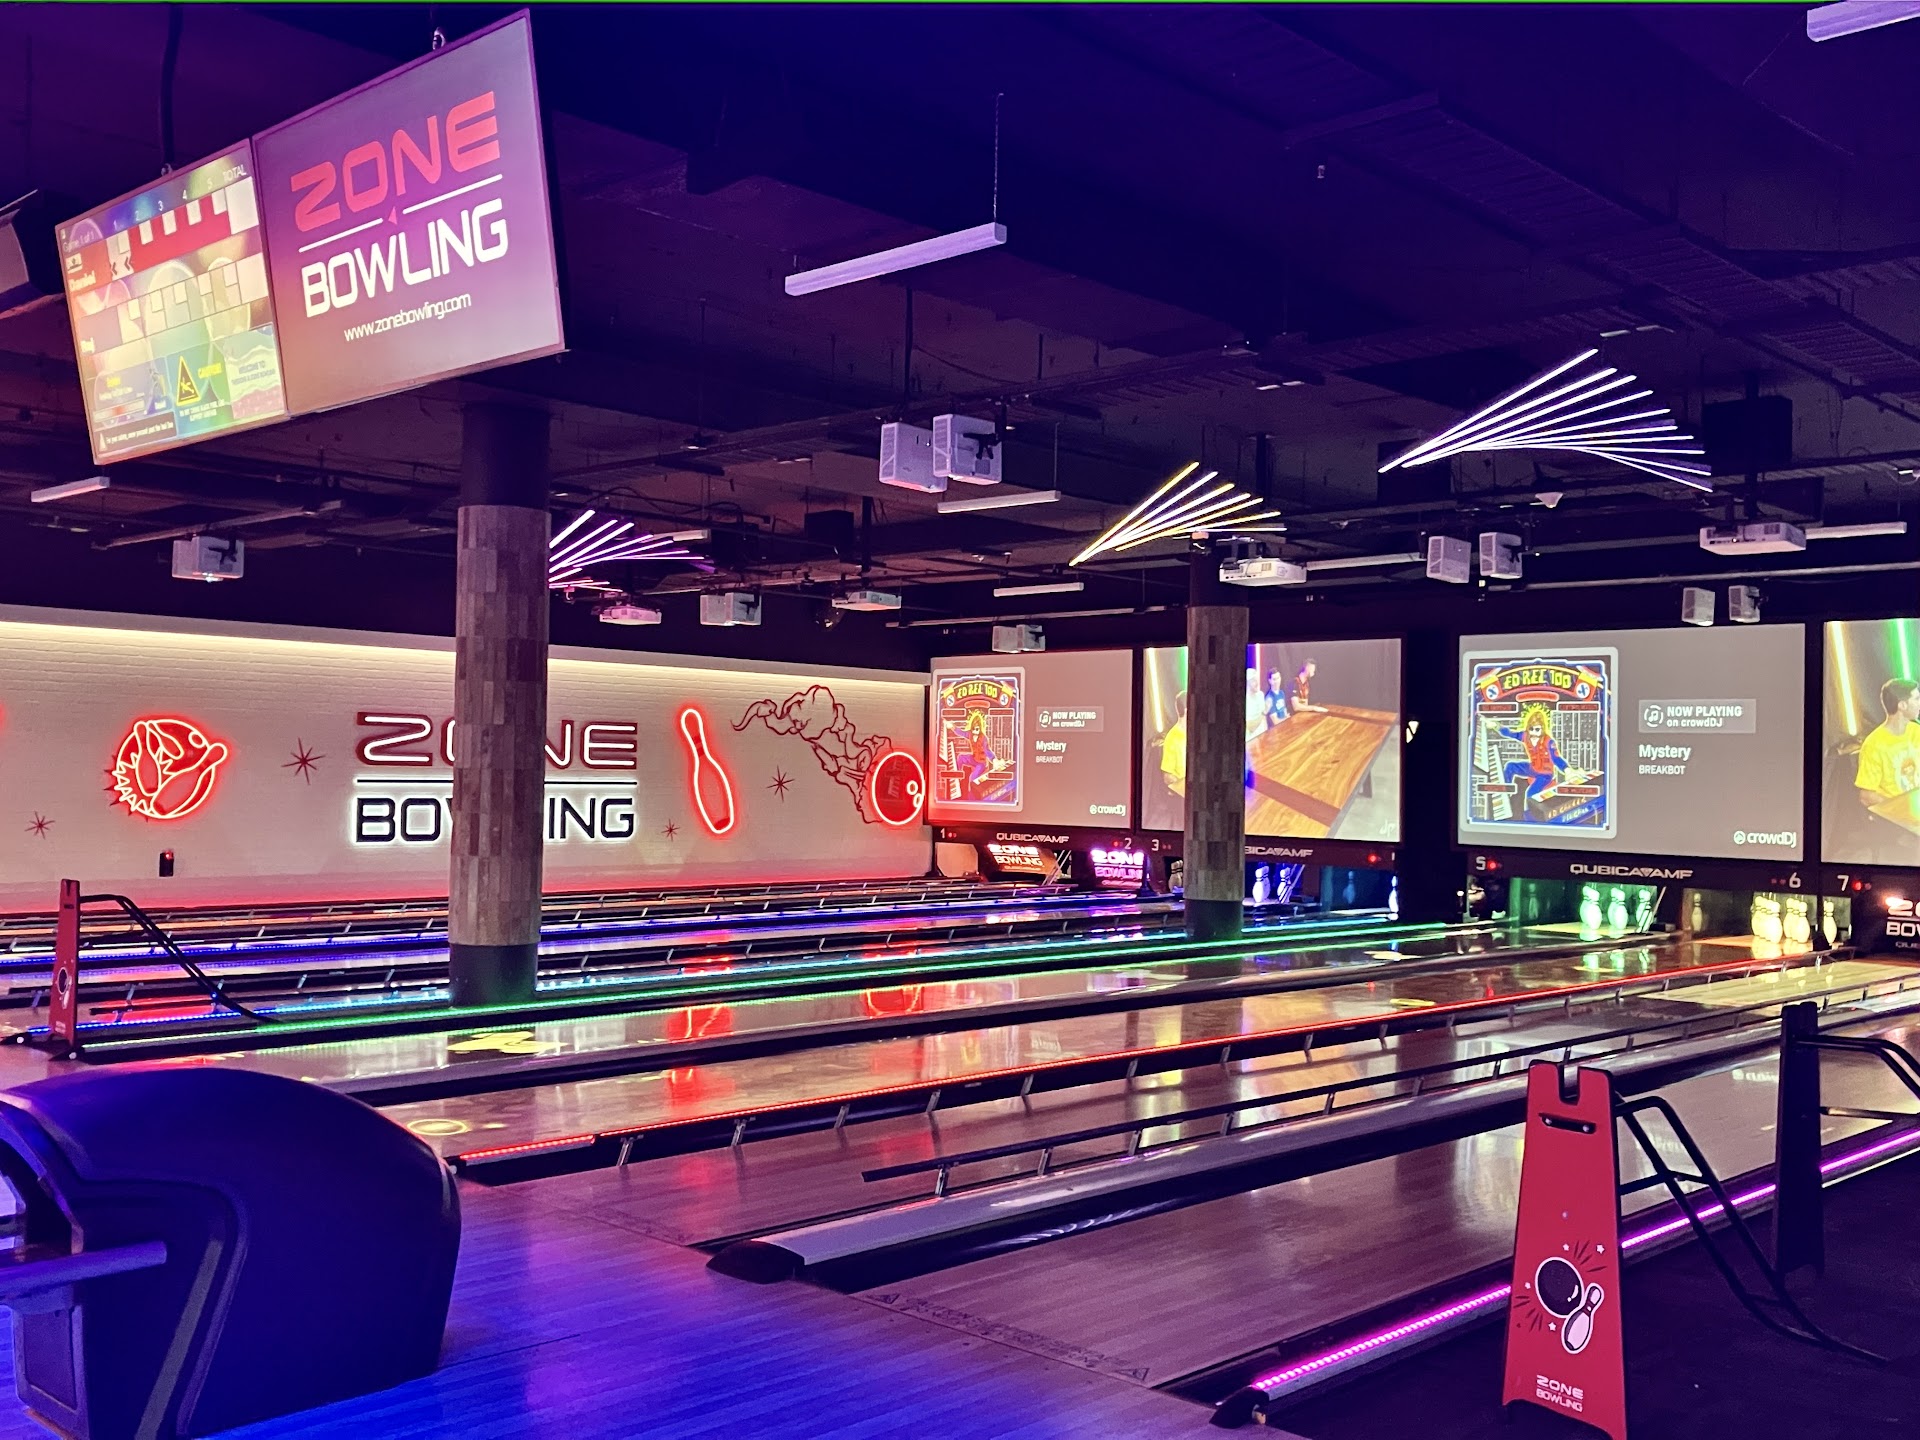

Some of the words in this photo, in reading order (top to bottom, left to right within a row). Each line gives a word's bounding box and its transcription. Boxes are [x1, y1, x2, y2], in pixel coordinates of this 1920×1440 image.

[290, 91, 500, 232] ZONE
[158, 200, 164, 212] 3
[182, 189, 188, 200] 4
[223, 164, 247, 182] TOTAL
[301, 198, 509, 318] BOWLING
[344, 293, 472, 342] www.zonebowling.com
[1052, 711, 1068, 720] NOW
[1069, 711, 1097, 720] PLAYING
[1666, 706, 1693, 717] NOW
[1695, 705, 1743, 717] PLAYING
[1666, 718, 1679, 728] on
[1680, 717, 1723, 728] crowdDJ
[1036, 740, 1067, 753] Mystery
[1638, 744, 1692, 761] Mystery
[1638, 764, 1686, 775] BREAKBOT
[355, 797, 636, 843] BOING
[940, 829, 946, 839] 1
[1746, 832, 1797, 848] crowdDJ
[987, 843, 1039, 855] ZONE
[1124, 837, 1132, 850] 2
[1151, 838, 1160, 851] 3
[993, 855, 1043, 867] BOWLING
[1476, 856, 1486, 871] 5
[1788, 872, 1801, 889] 6
[1837, 874, 1849, 892] 7
[1536, 1374, 1584, 1400] ZONE
[1536, 1388, 1583, 1413] BOWLING
